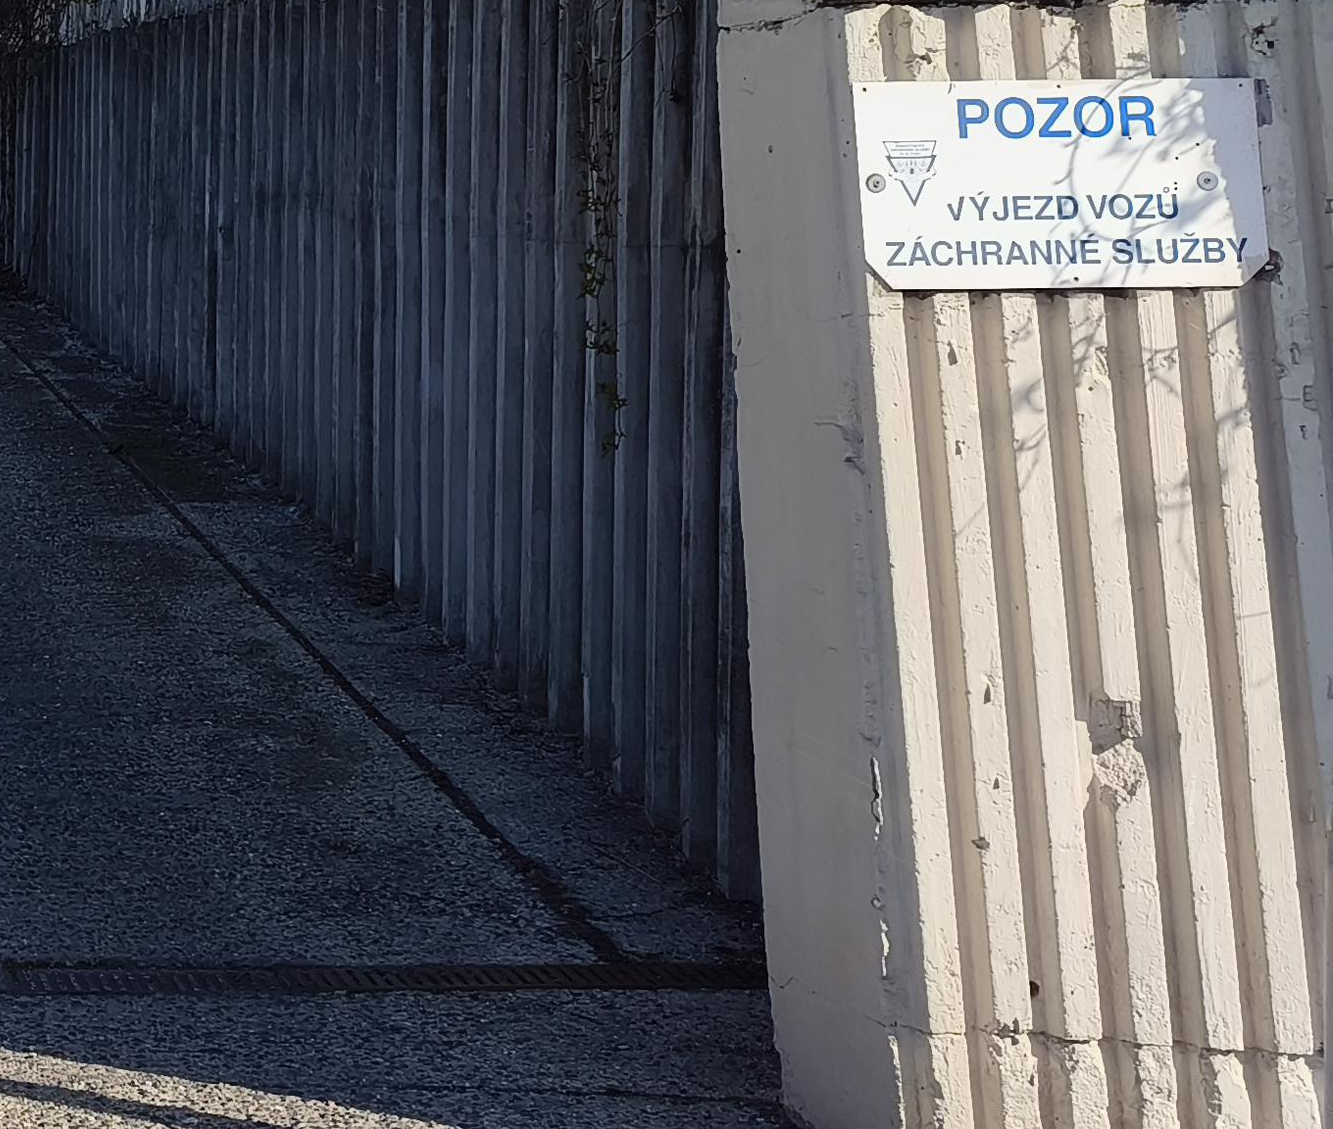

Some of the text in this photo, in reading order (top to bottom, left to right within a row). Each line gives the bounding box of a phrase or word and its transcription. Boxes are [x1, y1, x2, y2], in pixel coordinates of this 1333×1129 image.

[957, 95, 1157, 138] POZOR
[947, 186, 1179, 221] VÝJEZD VOZŮ
[885, 232, 1248, 267] ZÁCHRANNÉ SLUŽBY
